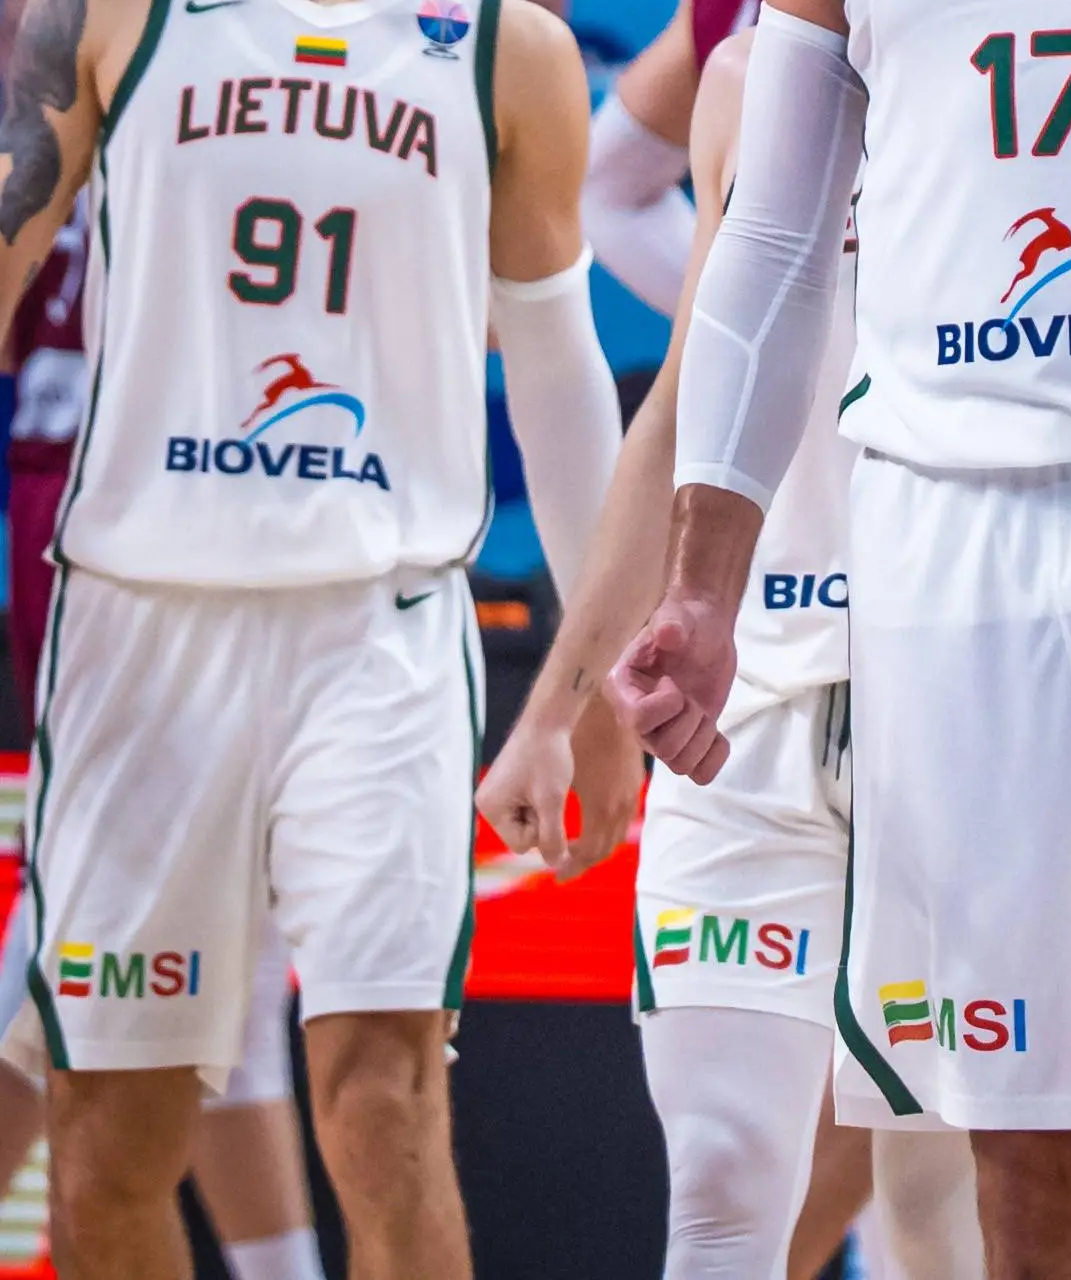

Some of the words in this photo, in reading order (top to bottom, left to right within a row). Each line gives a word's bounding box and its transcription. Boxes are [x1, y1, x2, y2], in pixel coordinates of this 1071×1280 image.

[175, 77, 438, 178] LIETUVA
[227, 196, 357, 315] 91
[165, 436, 391, 491] BIOVELA
